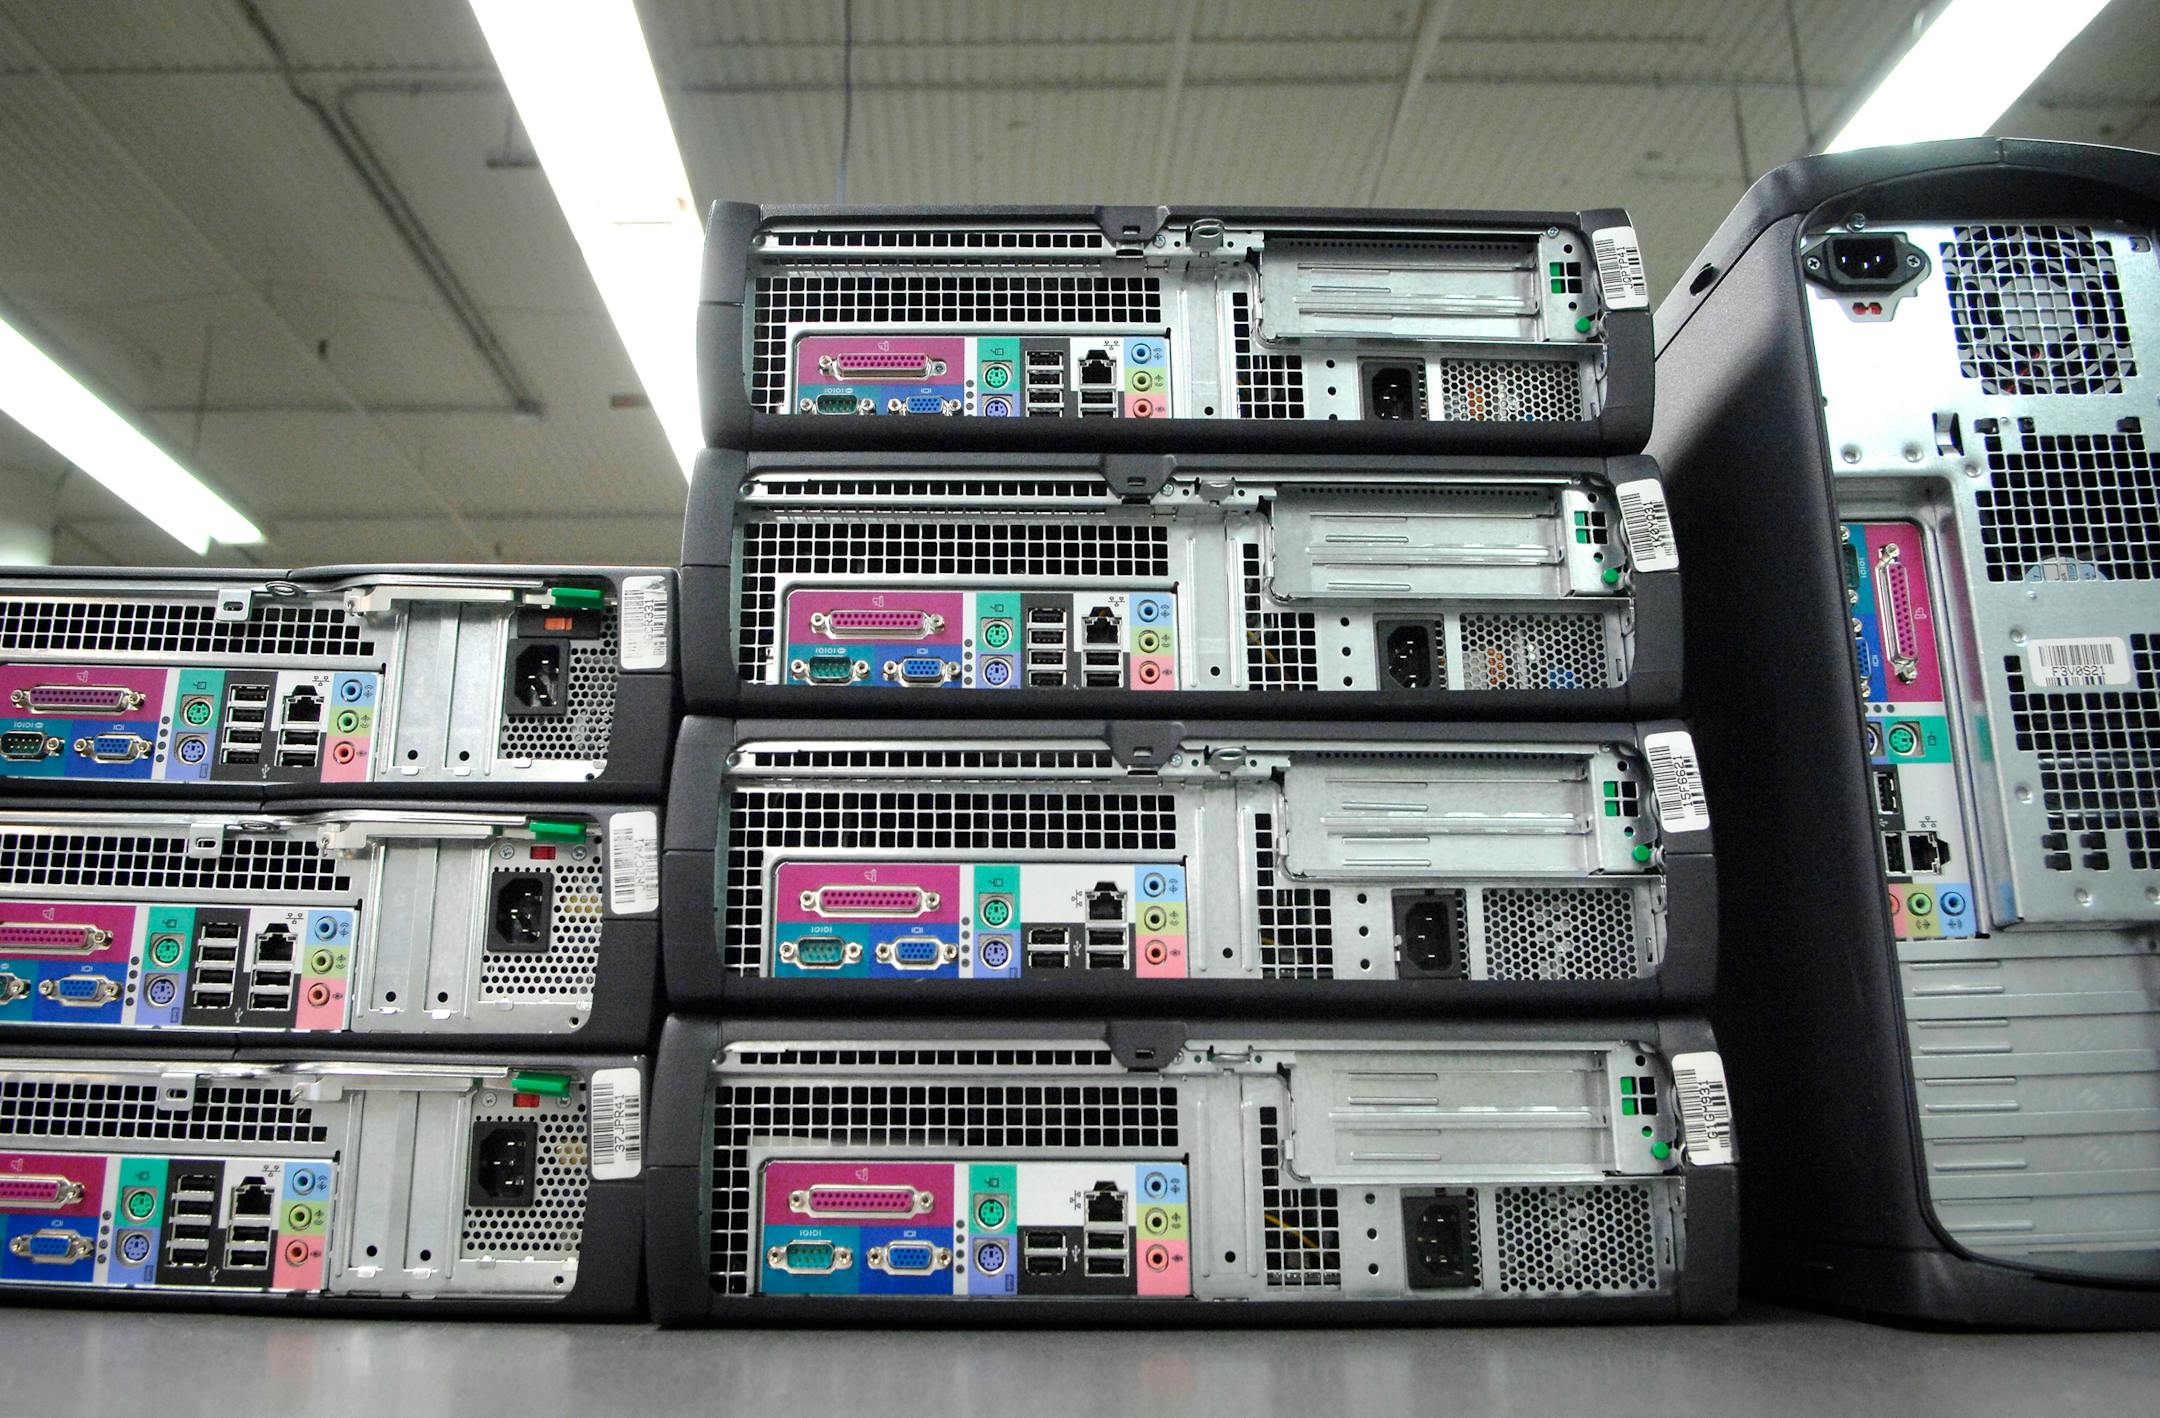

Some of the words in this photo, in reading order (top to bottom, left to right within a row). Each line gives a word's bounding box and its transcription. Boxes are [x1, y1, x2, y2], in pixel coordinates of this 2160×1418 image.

[1616, 246, 1633, 289] JQPTP41
[2052, 665, 2106, 677] F3V0S21
[1672, 755, 1693, 806] 15F6621
[614, 1094, 625, 1153] 37JPR41
